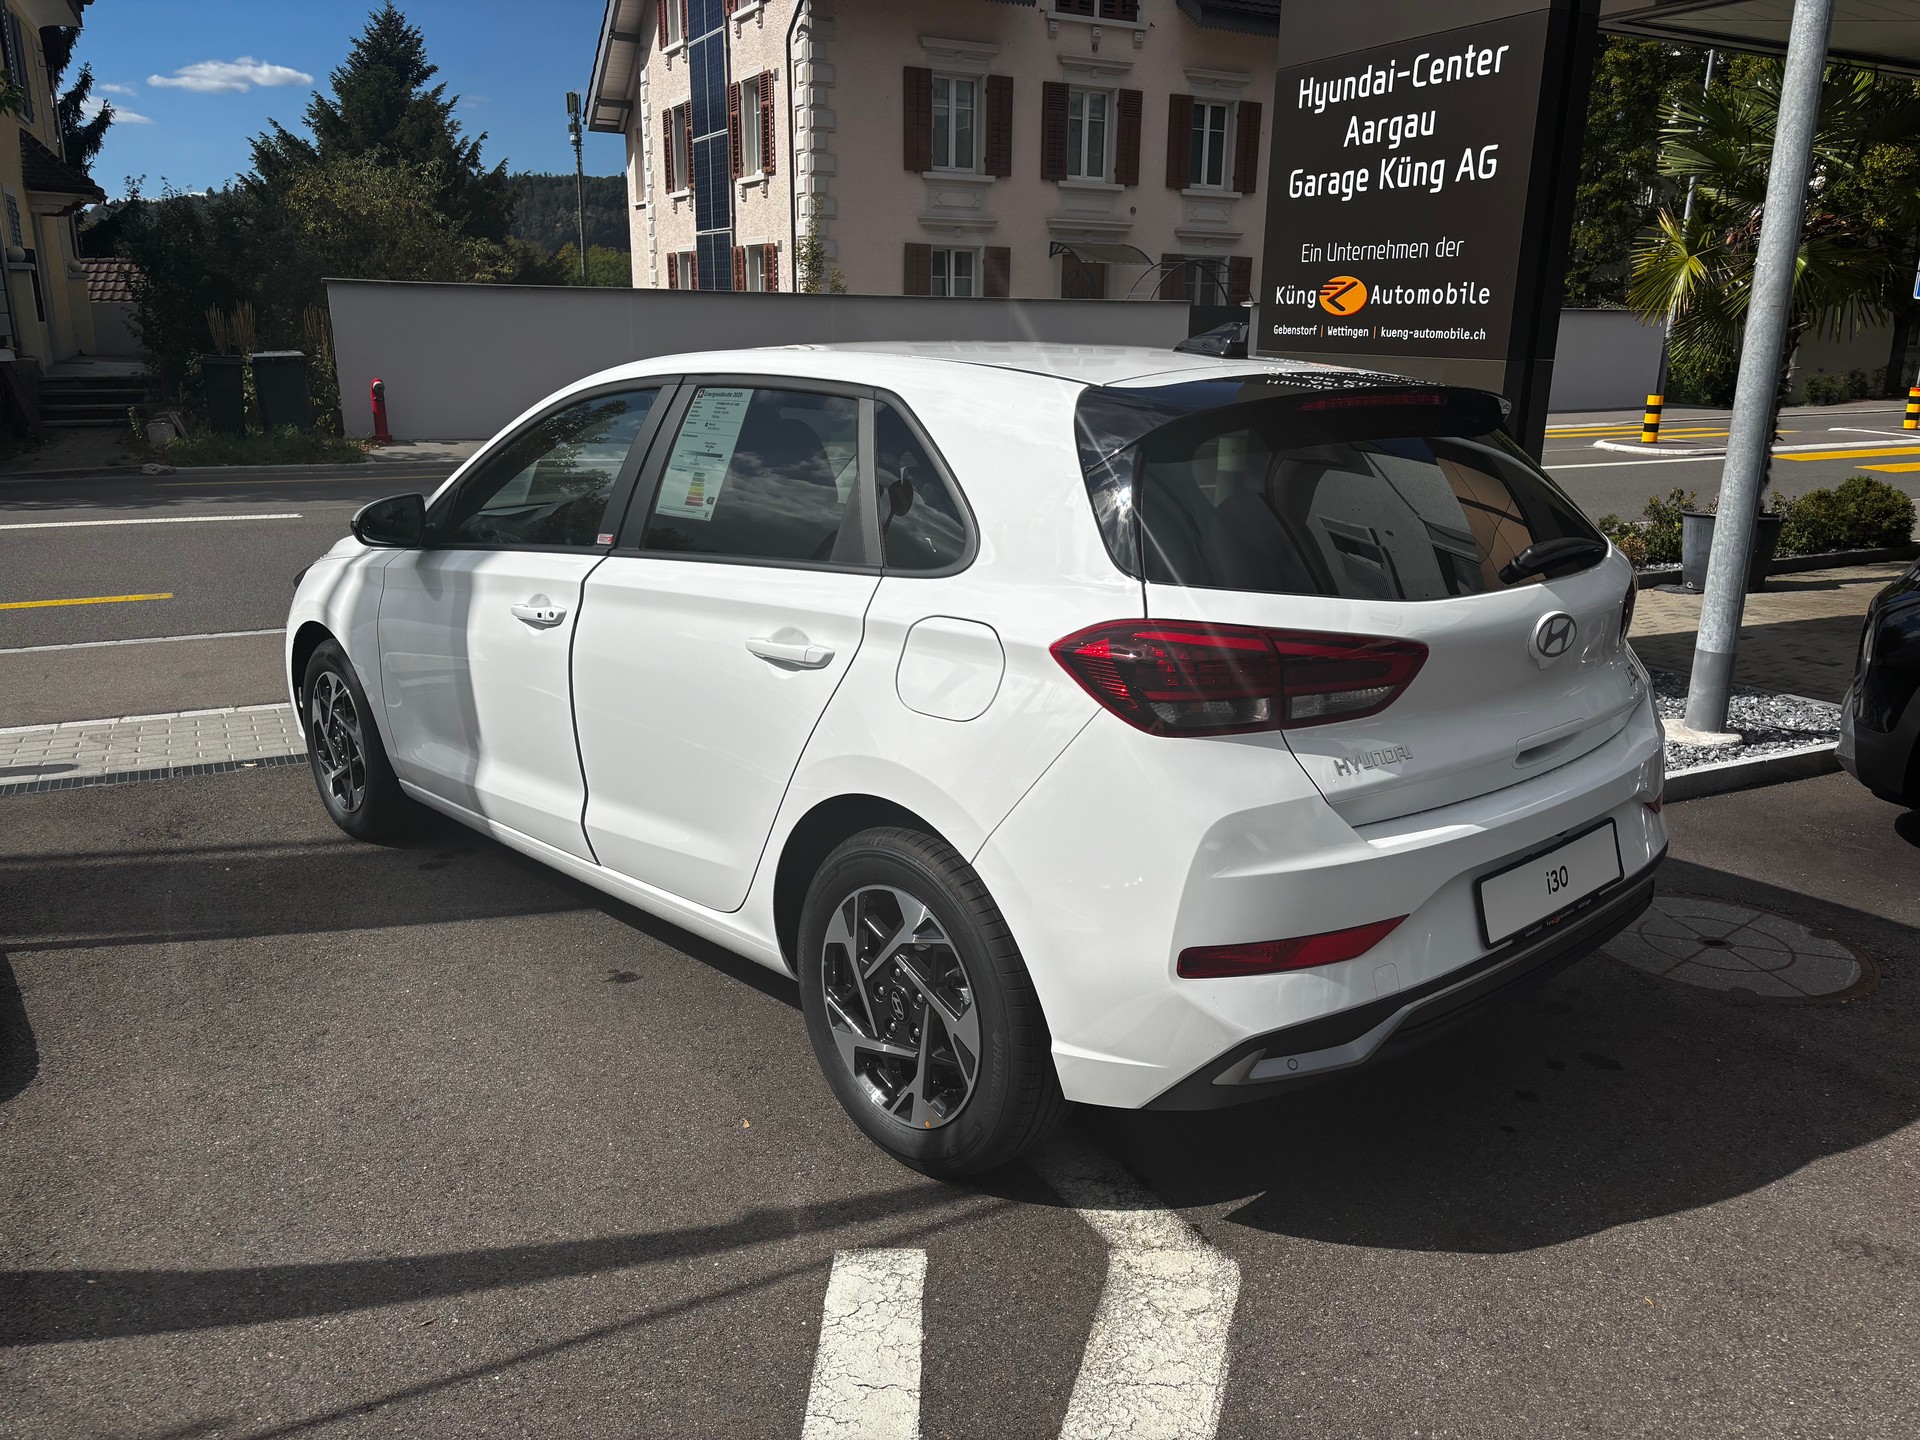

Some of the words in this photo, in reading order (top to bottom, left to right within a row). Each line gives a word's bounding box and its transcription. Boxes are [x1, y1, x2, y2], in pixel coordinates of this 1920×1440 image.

[1298, 44, 1510, 114] Hyundai-Center
[1343, 110, 1436, 149] Aargau
[1289, 167, 1369, 201] Garage
[1379, 156, 1446, 194] Küng
[1455, 144, 1499, 182] AG
[1301, 242, 1322, 263] Ein
[1327, 240, 1429, 263] Unternehmen
[1435, 236, 1464, 258] der
[1275, 285, 1317, 309] Küng
[1370, 281, 1490, 305] Automobile
[1273, 324, 1317, 336] Gebenstorf
[1327, 325, 1369, 339] Wettingen
[1380, 326, 1486, 341] kueng-automobile.ch
[1333, 745, 1414, 777] HYUNDAI
[1545, 865, 1569, 895] i30
